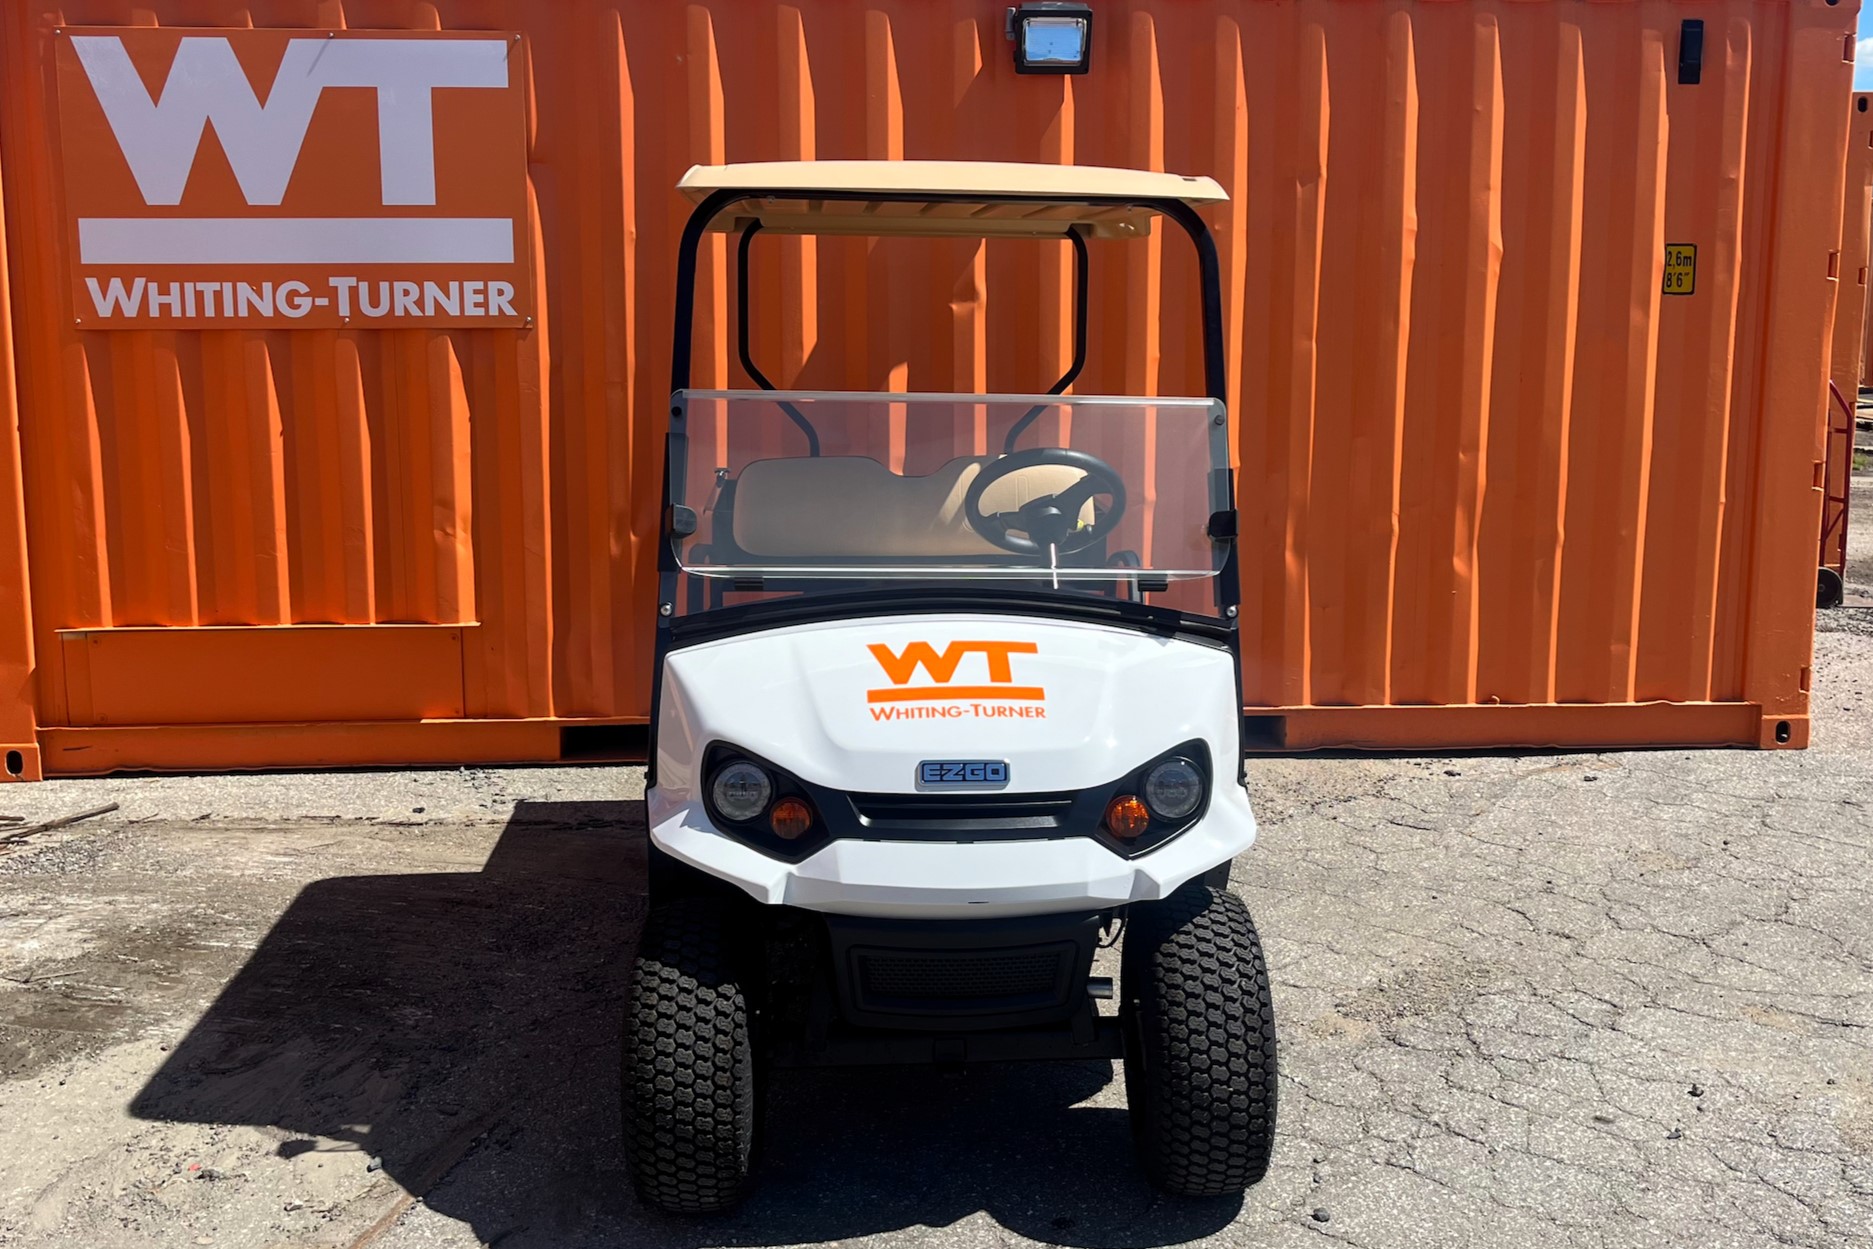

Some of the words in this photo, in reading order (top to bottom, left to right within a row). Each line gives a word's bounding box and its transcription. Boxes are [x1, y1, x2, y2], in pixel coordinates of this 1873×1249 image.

[69, 36, 509, 206] WT
[866, 640, 1038, 685] WT
[923, 763, 1005, 781] EZGO
